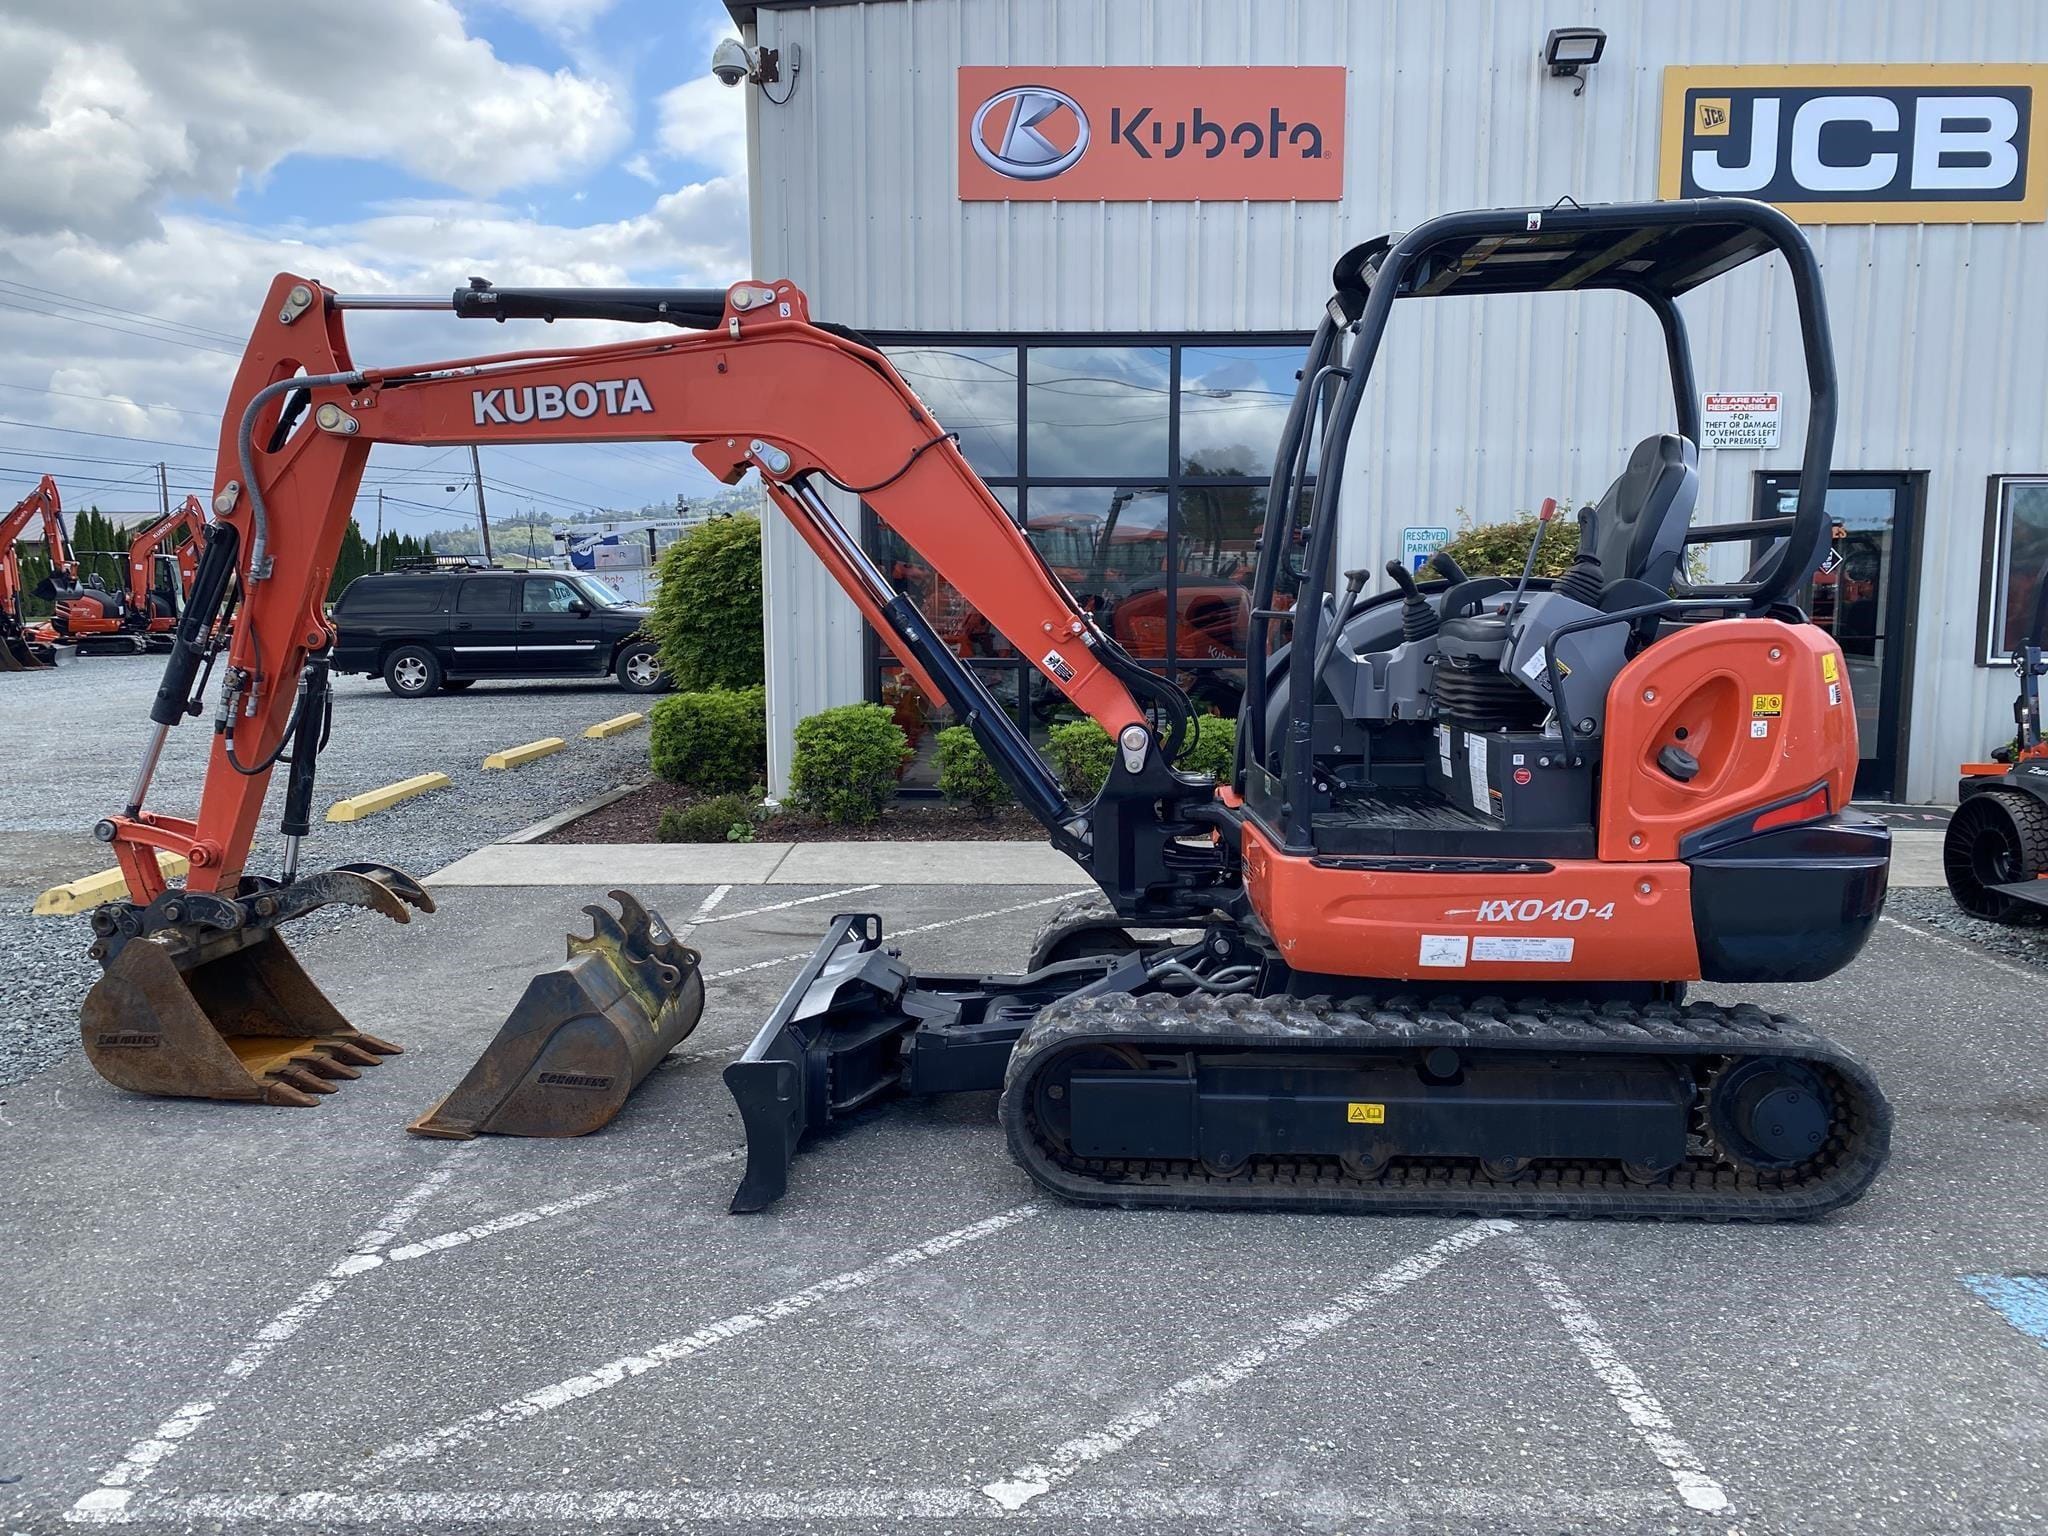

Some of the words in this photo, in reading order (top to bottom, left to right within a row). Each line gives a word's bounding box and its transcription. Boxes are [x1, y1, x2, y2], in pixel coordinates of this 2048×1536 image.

[1111, 107, 1323, 159] Kubota
[1705, 108, 1723, 126] JCB
[1692, 96, 2019, 191] JCB
[472, 379, 653, 424] KUBOTA
[1407, 532, 1445, 540] RESERVED
[1476, 899, 1615, 921] KX040-4
